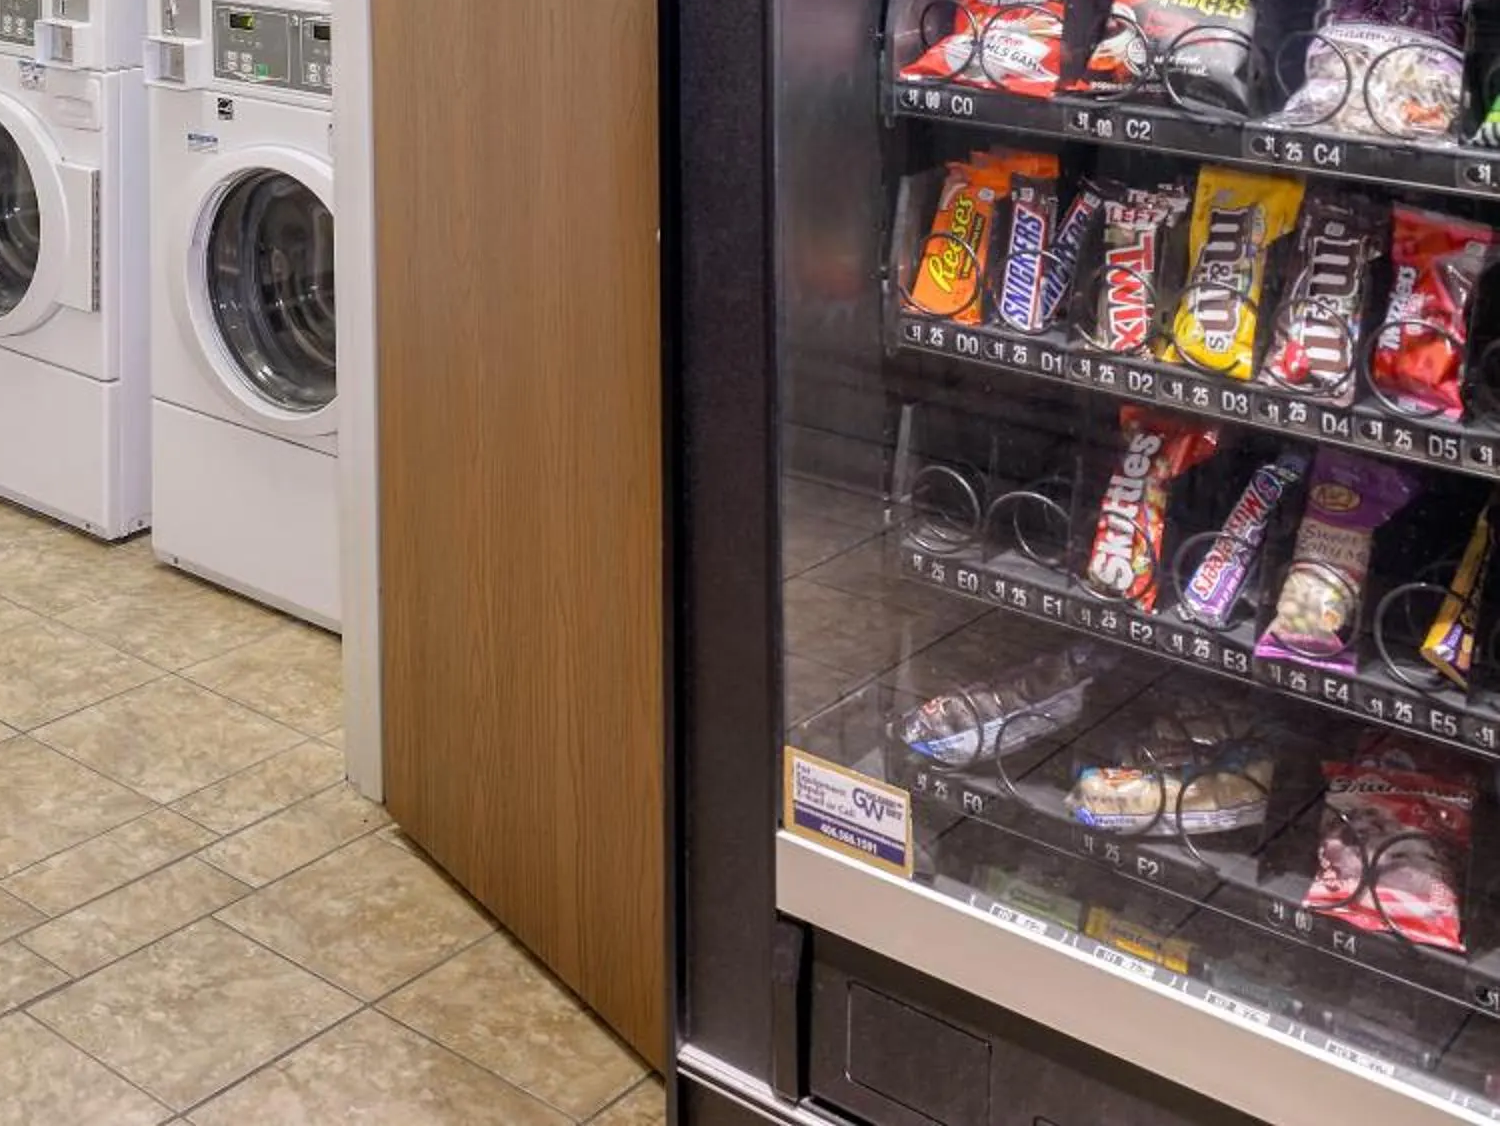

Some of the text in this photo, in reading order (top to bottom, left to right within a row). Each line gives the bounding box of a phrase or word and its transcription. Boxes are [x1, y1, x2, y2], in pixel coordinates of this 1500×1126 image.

[951, 95, 973, 115] C0
[1126, 119, 1151, 140] C2
[1313, 143, 1341, 166] C4
[1003, 209, 1043, 326] SNICKERS
[956, 334, 979, 355] D0
[1041, 351, 1064, 373] D1
[1128, 371, 1153, 394] D2
[1221, 391, 1249, 415] D3
[1321, 412, 1350, 437] D4
[1428, 435, 1458, 460] D5
[1091, 432, 1162, 592] Skittles
[957, 569, 979, 592] E0
[1043, 595, 1063, 617] E1
[1130, 621, 1153, 643] E2
[1222, 649, 1248, 673] E3
[1324, 678, 1350, 703] E4
[1429, 710, 1458, 737] E5
